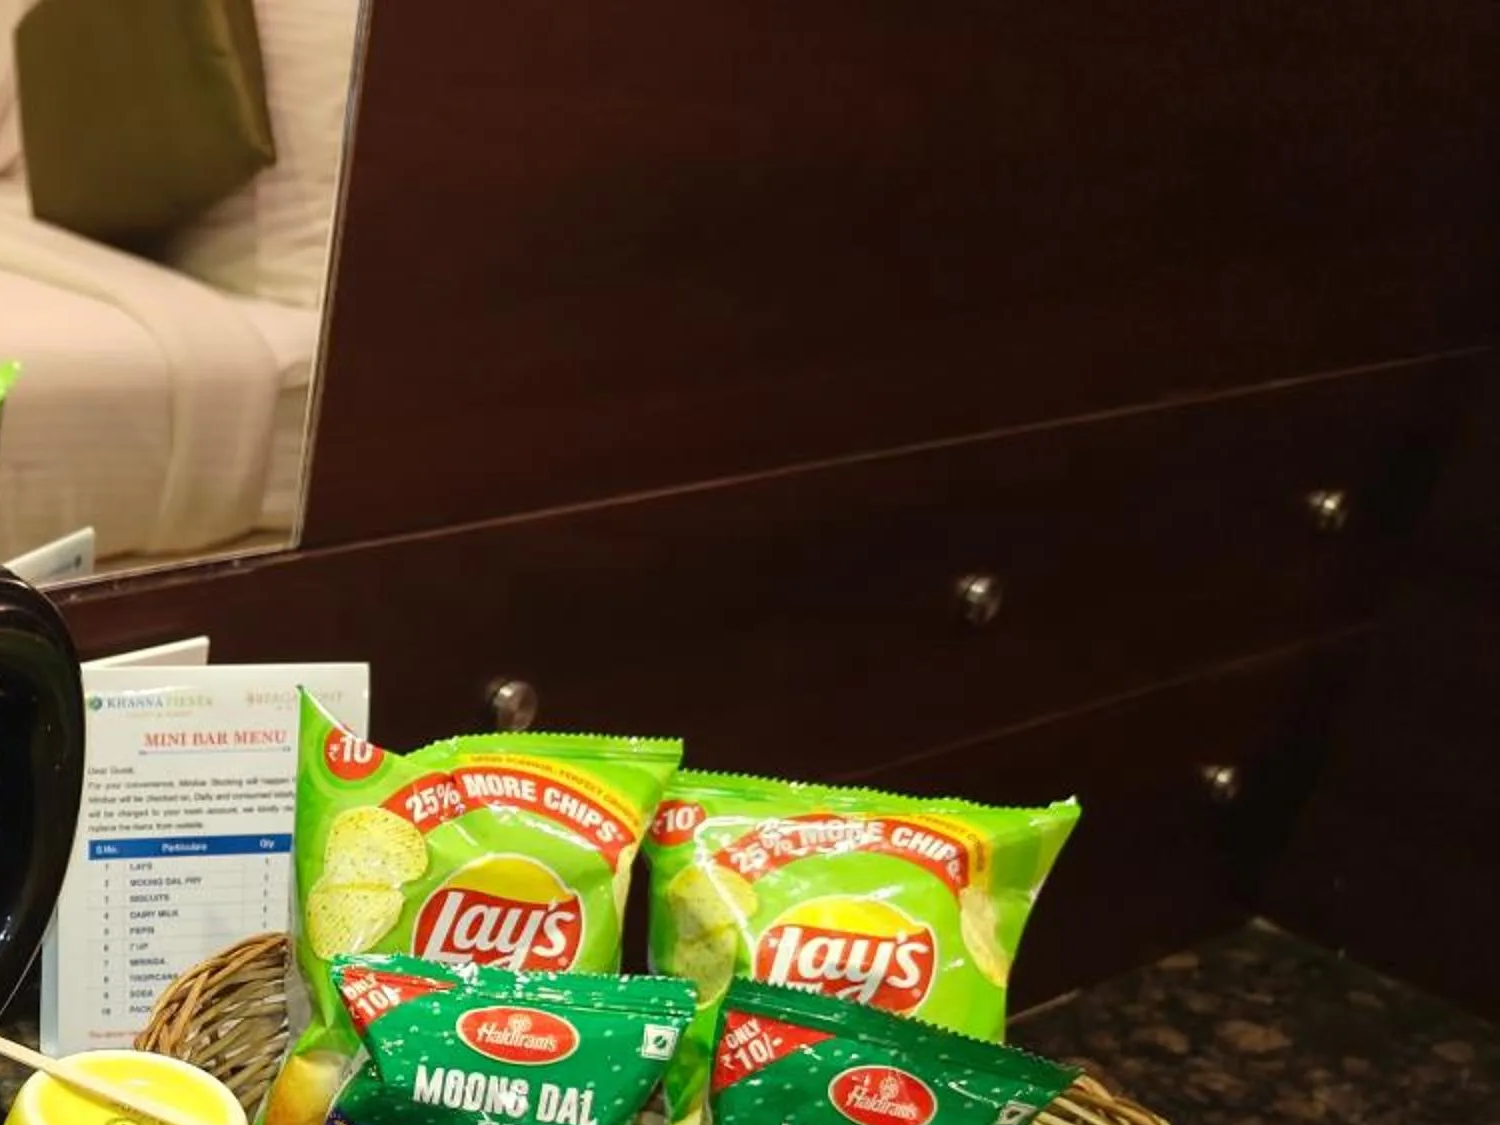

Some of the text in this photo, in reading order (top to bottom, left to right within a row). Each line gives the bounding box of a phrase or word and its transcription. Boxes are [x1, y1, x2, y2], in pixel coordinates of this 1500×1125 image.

[144, 729, 287, 747] MINI BAR MENU
[404, 783, 462, 823] 25%
[461, 773, 538, 803] MORE
[543, 786, 618, 842] CHIPS
[422, 891, 575, 970] Lay's
[768, 926, 930, 1002] Lay's
[476, 1019, 559, 1053] Haldiram's
[725, 1017, 761, 1049] ONLY
[411, 1064, 530, 1115] MOONG
